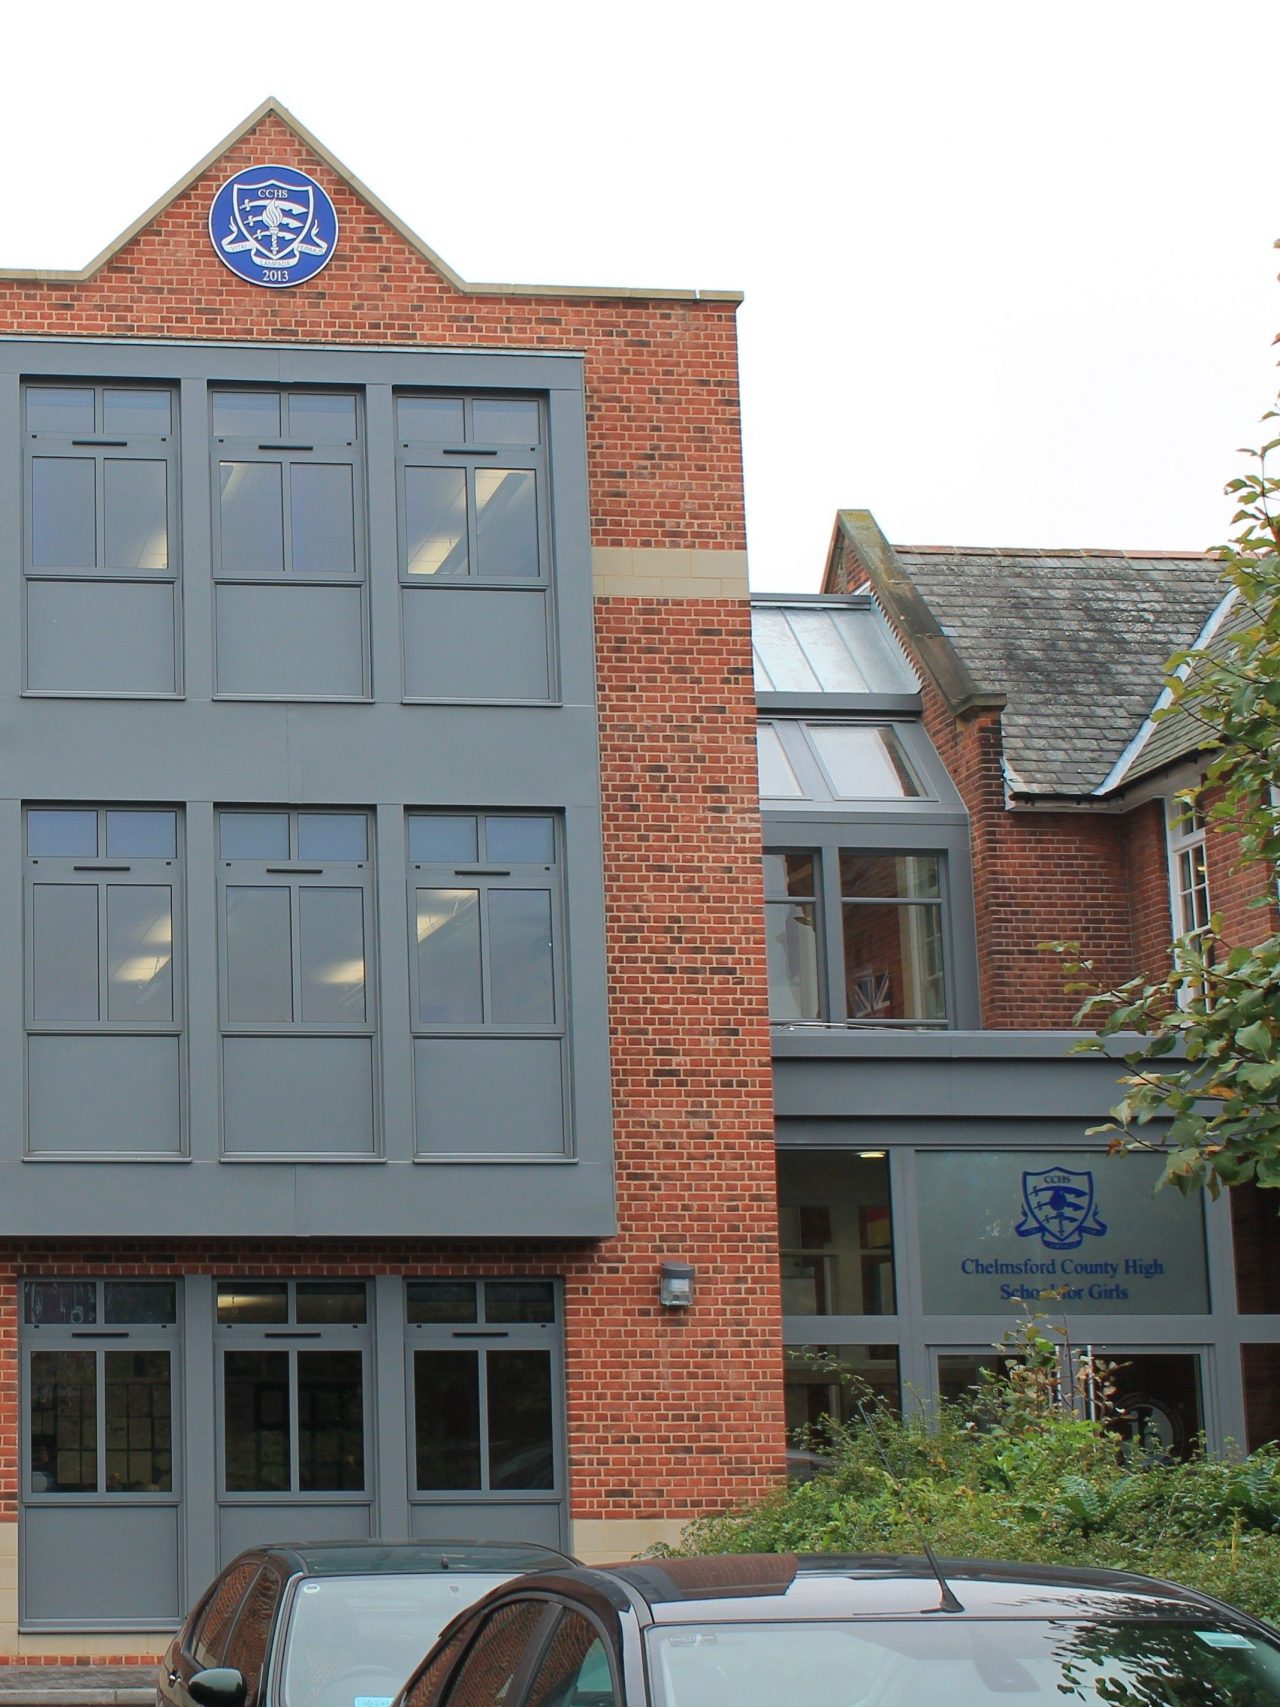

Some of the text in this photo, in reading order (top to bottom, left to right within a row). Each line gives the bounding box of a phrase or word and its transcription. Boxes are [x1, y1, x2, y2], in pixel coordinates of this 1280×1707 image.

[258, 189, 288, 199] CCHS
[262, 269, 289, 282] 2013
[1044, 1175, 1071, 1184] CCHS
[961, 1258, 1165, 1279] Chelmsford County High
[1000, 1283, 1056, 1300] Scho
[1088, 1284, 1129, 1300] Girls
